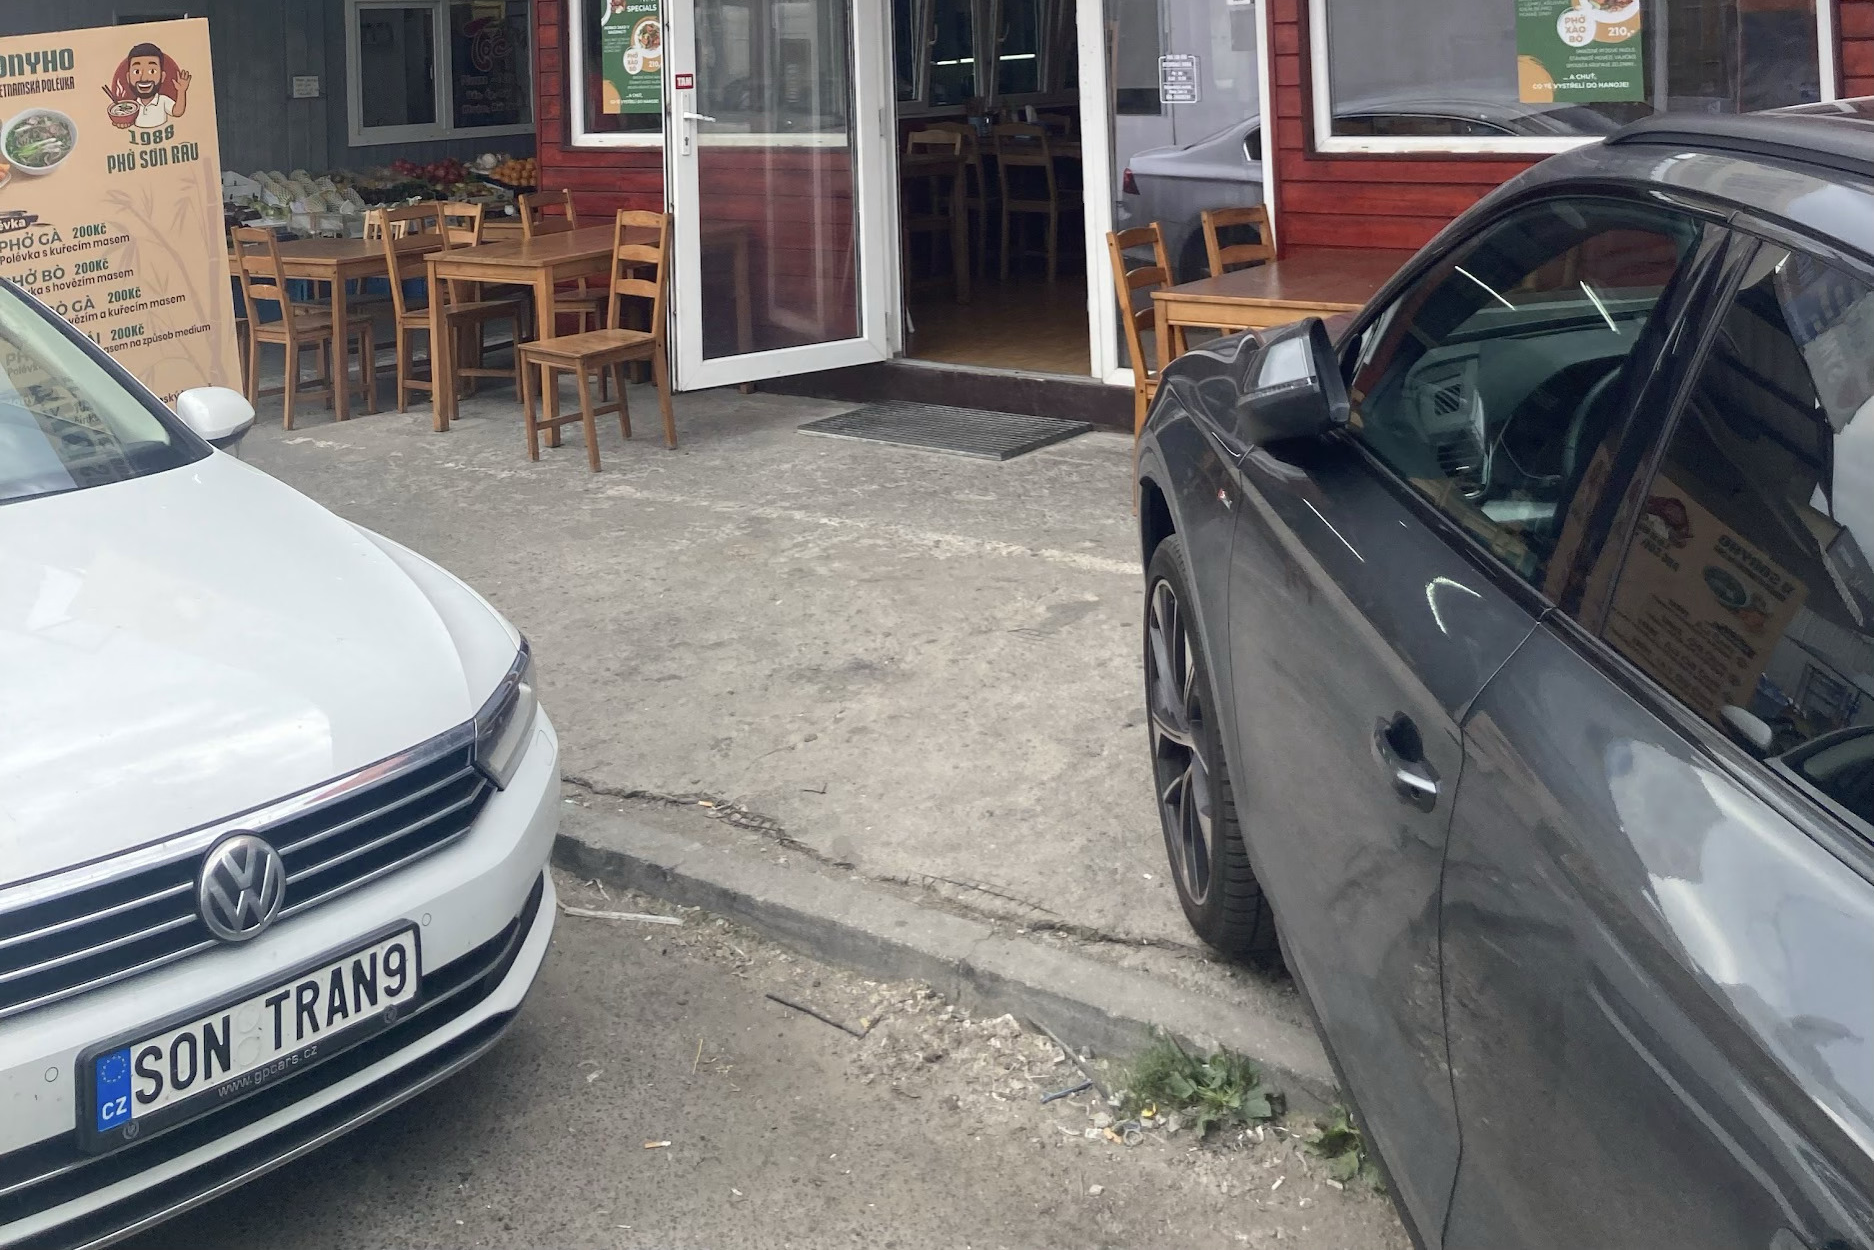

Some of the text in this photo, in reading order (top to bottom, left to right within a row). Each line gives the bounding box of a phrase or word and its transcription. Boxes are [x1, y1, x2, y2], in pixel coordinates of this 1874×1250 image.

[626, 4, 657, 13] SPECIALS
[128, 124, 174, 146] 1988
[38, 228, 62, 246] GÀ
[72, 222, 107, 239] 200Kč
[0, 249, 40, 265] Polévka
[50, 241, 92, 256] kuřecím
[95, 234, 130, 247] masem
[42, 264, 65, 282] BÒ
[74, 258, 109, 276] 200Kč
[52, 276, 95, 291] hovězím
[97, 269, 134, 283] masem
[71, 295, 96, 313] GÀ
[107, 286, 142, 304] 200Kč
[100, 311, 106, 319] a
[108, 301, 148, 317] kuřecím
[150, 294, 186, 308] masem
[110, 323, 145, 341] 200Kč
[130, 339, 141, 349] na
[134, 942, 408, 1105] SON TRAN9
[218, 1045, 318, 1097] www.gpcars.cz
[101, 1095, 128, 1121] CZ
